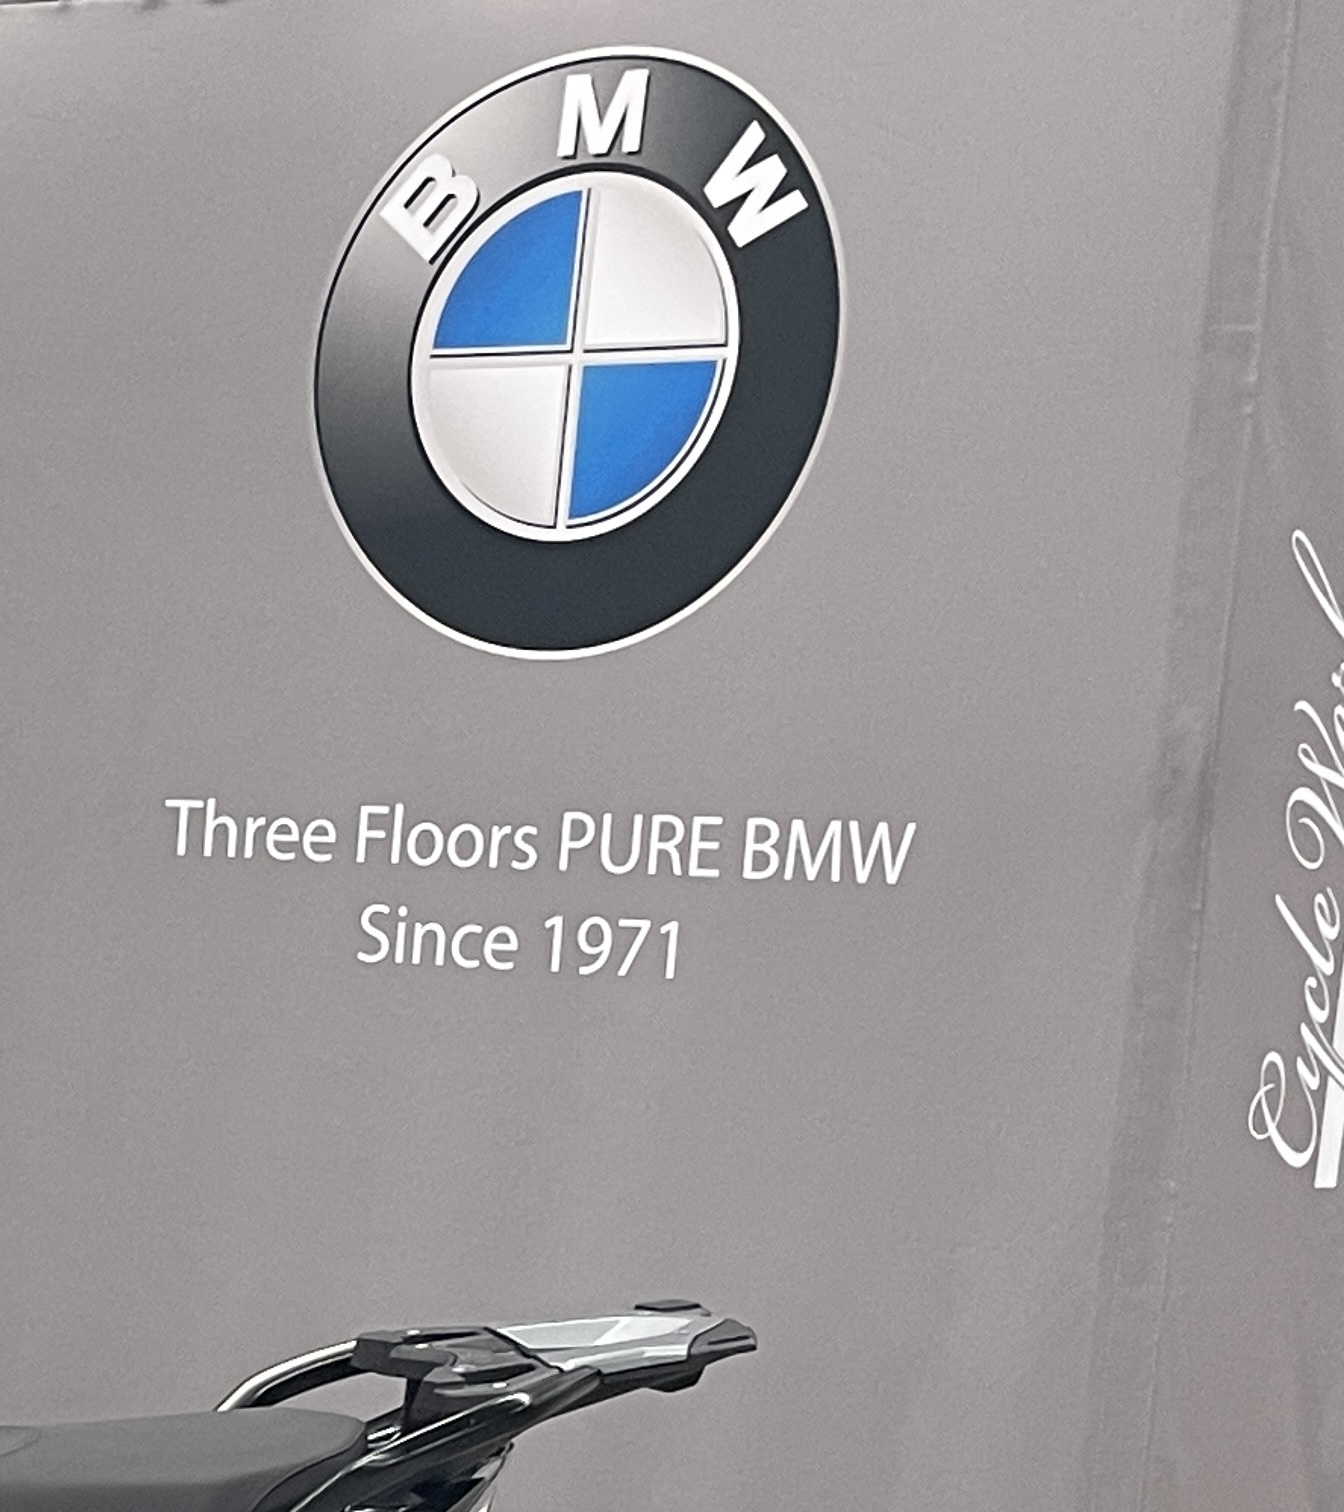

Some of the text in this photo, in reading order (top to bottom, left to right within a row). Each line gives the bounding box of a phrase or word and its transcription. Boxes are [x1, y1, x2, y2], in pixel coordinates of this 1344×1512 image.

[378, 66, 810, 264] BMW
[164, 796, 918, 886] Three Floors PURE BMW
[356, 903, 680, 981] Since 1971
